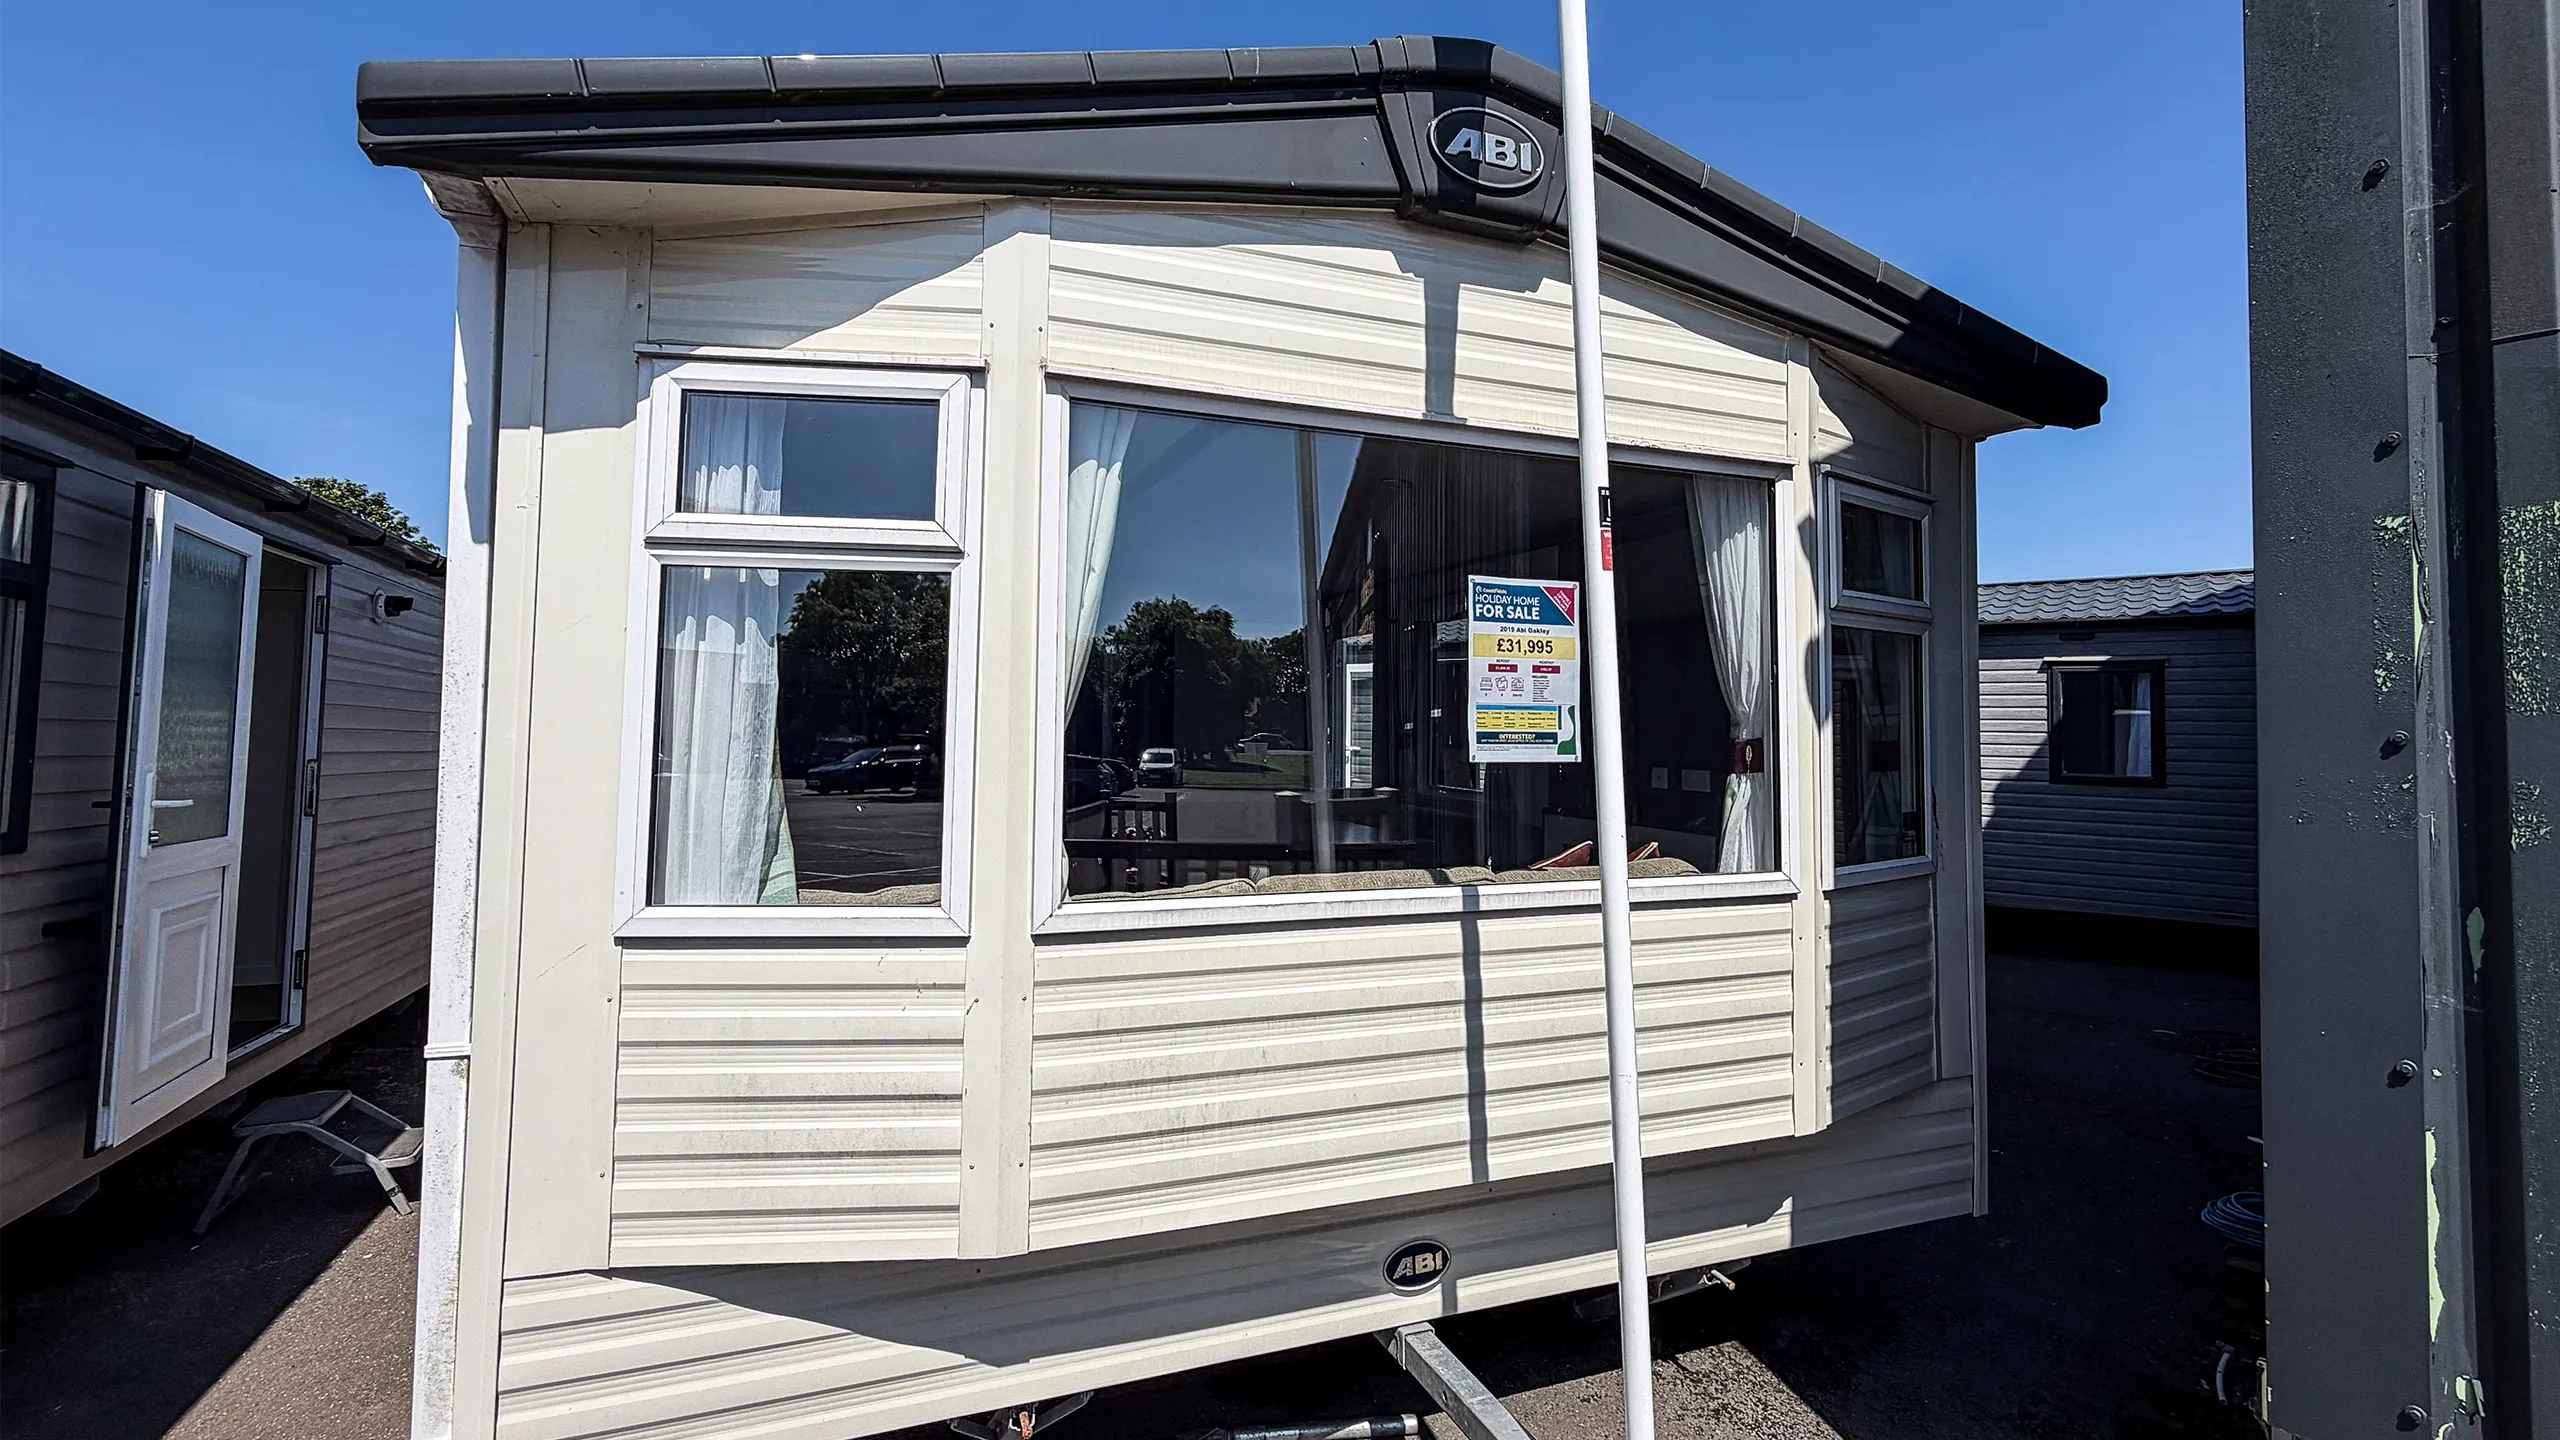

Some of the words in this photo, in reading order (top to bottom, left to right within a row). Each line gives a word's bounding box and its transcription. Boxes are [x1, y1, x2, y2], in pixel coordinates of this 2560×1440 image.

[1444, 127, 1532, 173] ABI
[1475, 594, 1512, 604] HOLIDAY
[1513, 596, 1540, 606] HOME
[1475, 604, 1504, 618] FOR
[1506, 606, 1540, 620] SALE
[1528, 627, 1550, 635] Oakley
[1496, 638, 1553, 656] £31,995
[1392, 1250, 1443, 1279] ABI
